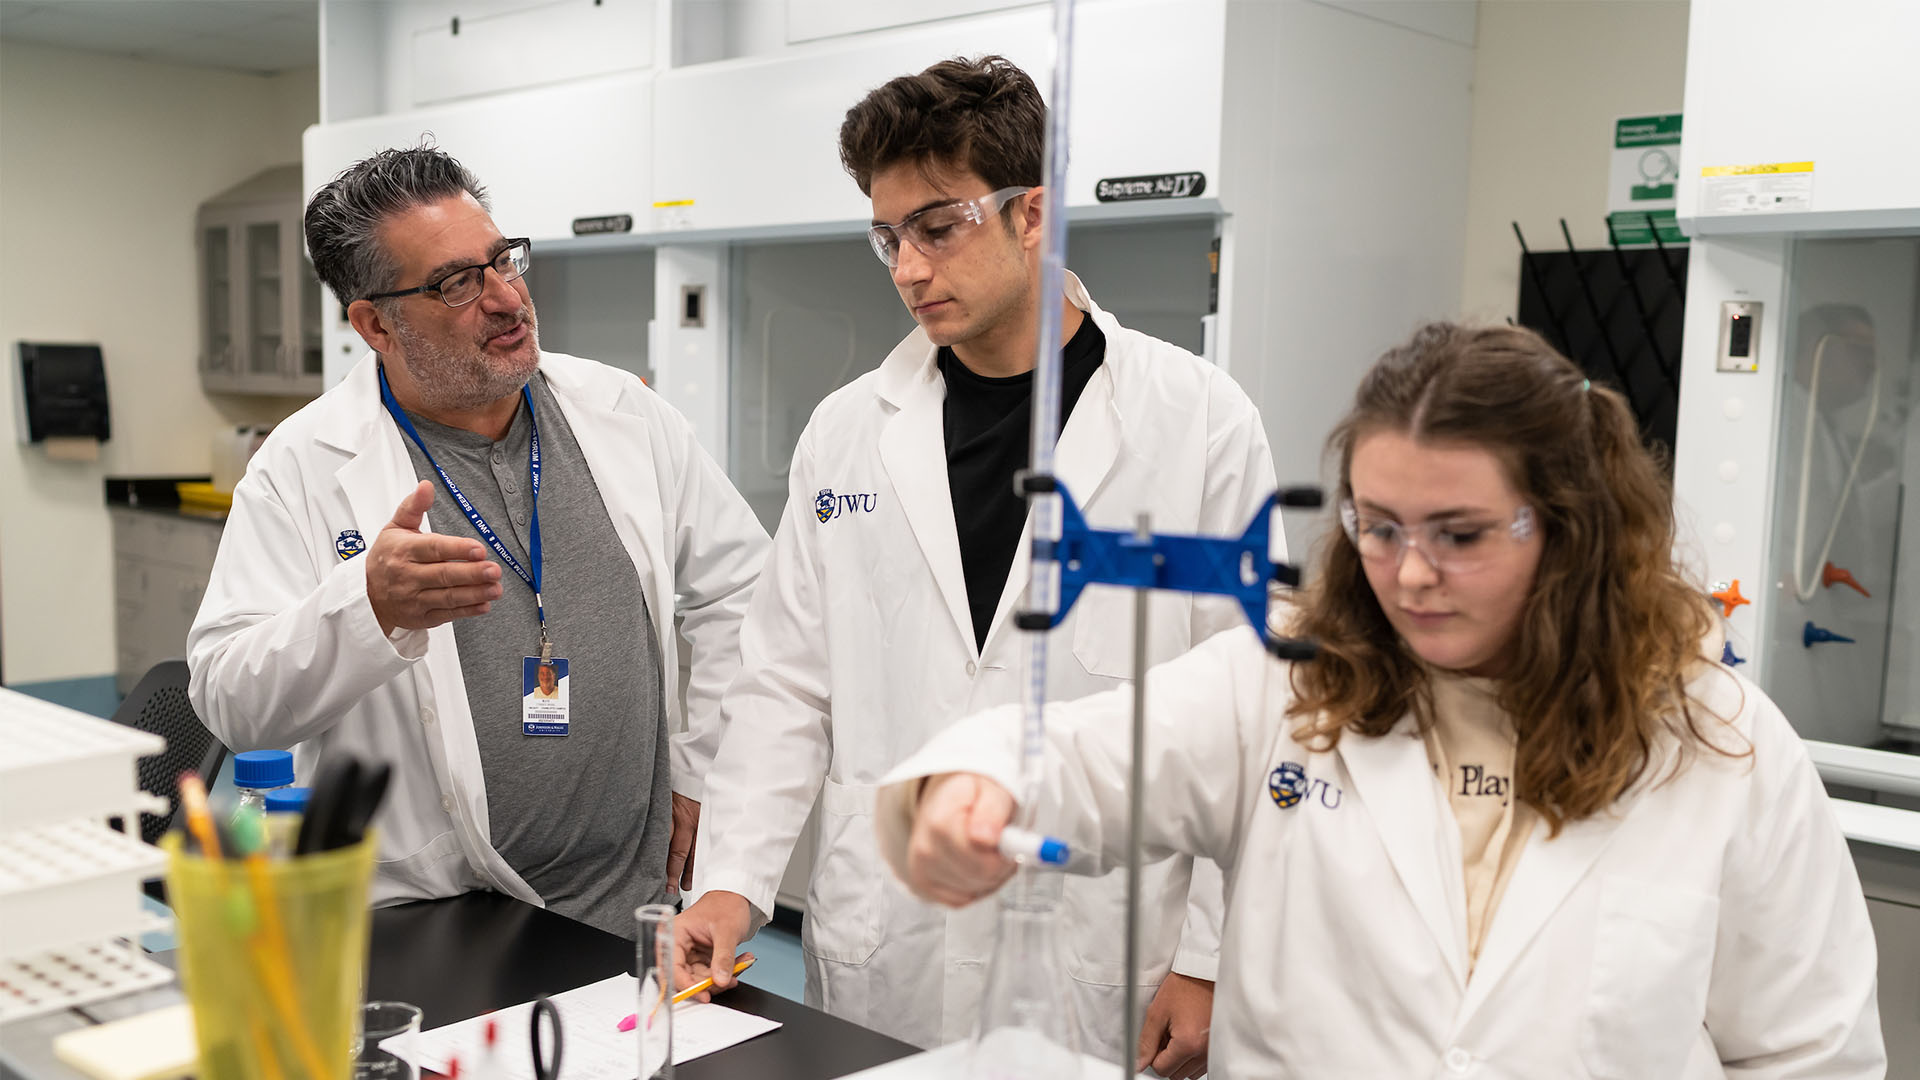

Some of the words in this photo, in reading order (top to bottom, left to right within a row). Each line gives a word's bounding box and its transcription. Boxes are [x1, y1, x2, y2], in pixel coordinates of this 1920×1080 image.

[456, 492, 472, 512] SEEM
[833, 493, 877, 519] JWU
[475, 519, 491, 535] JWU
[493, 540, 516, 567] FORUM
